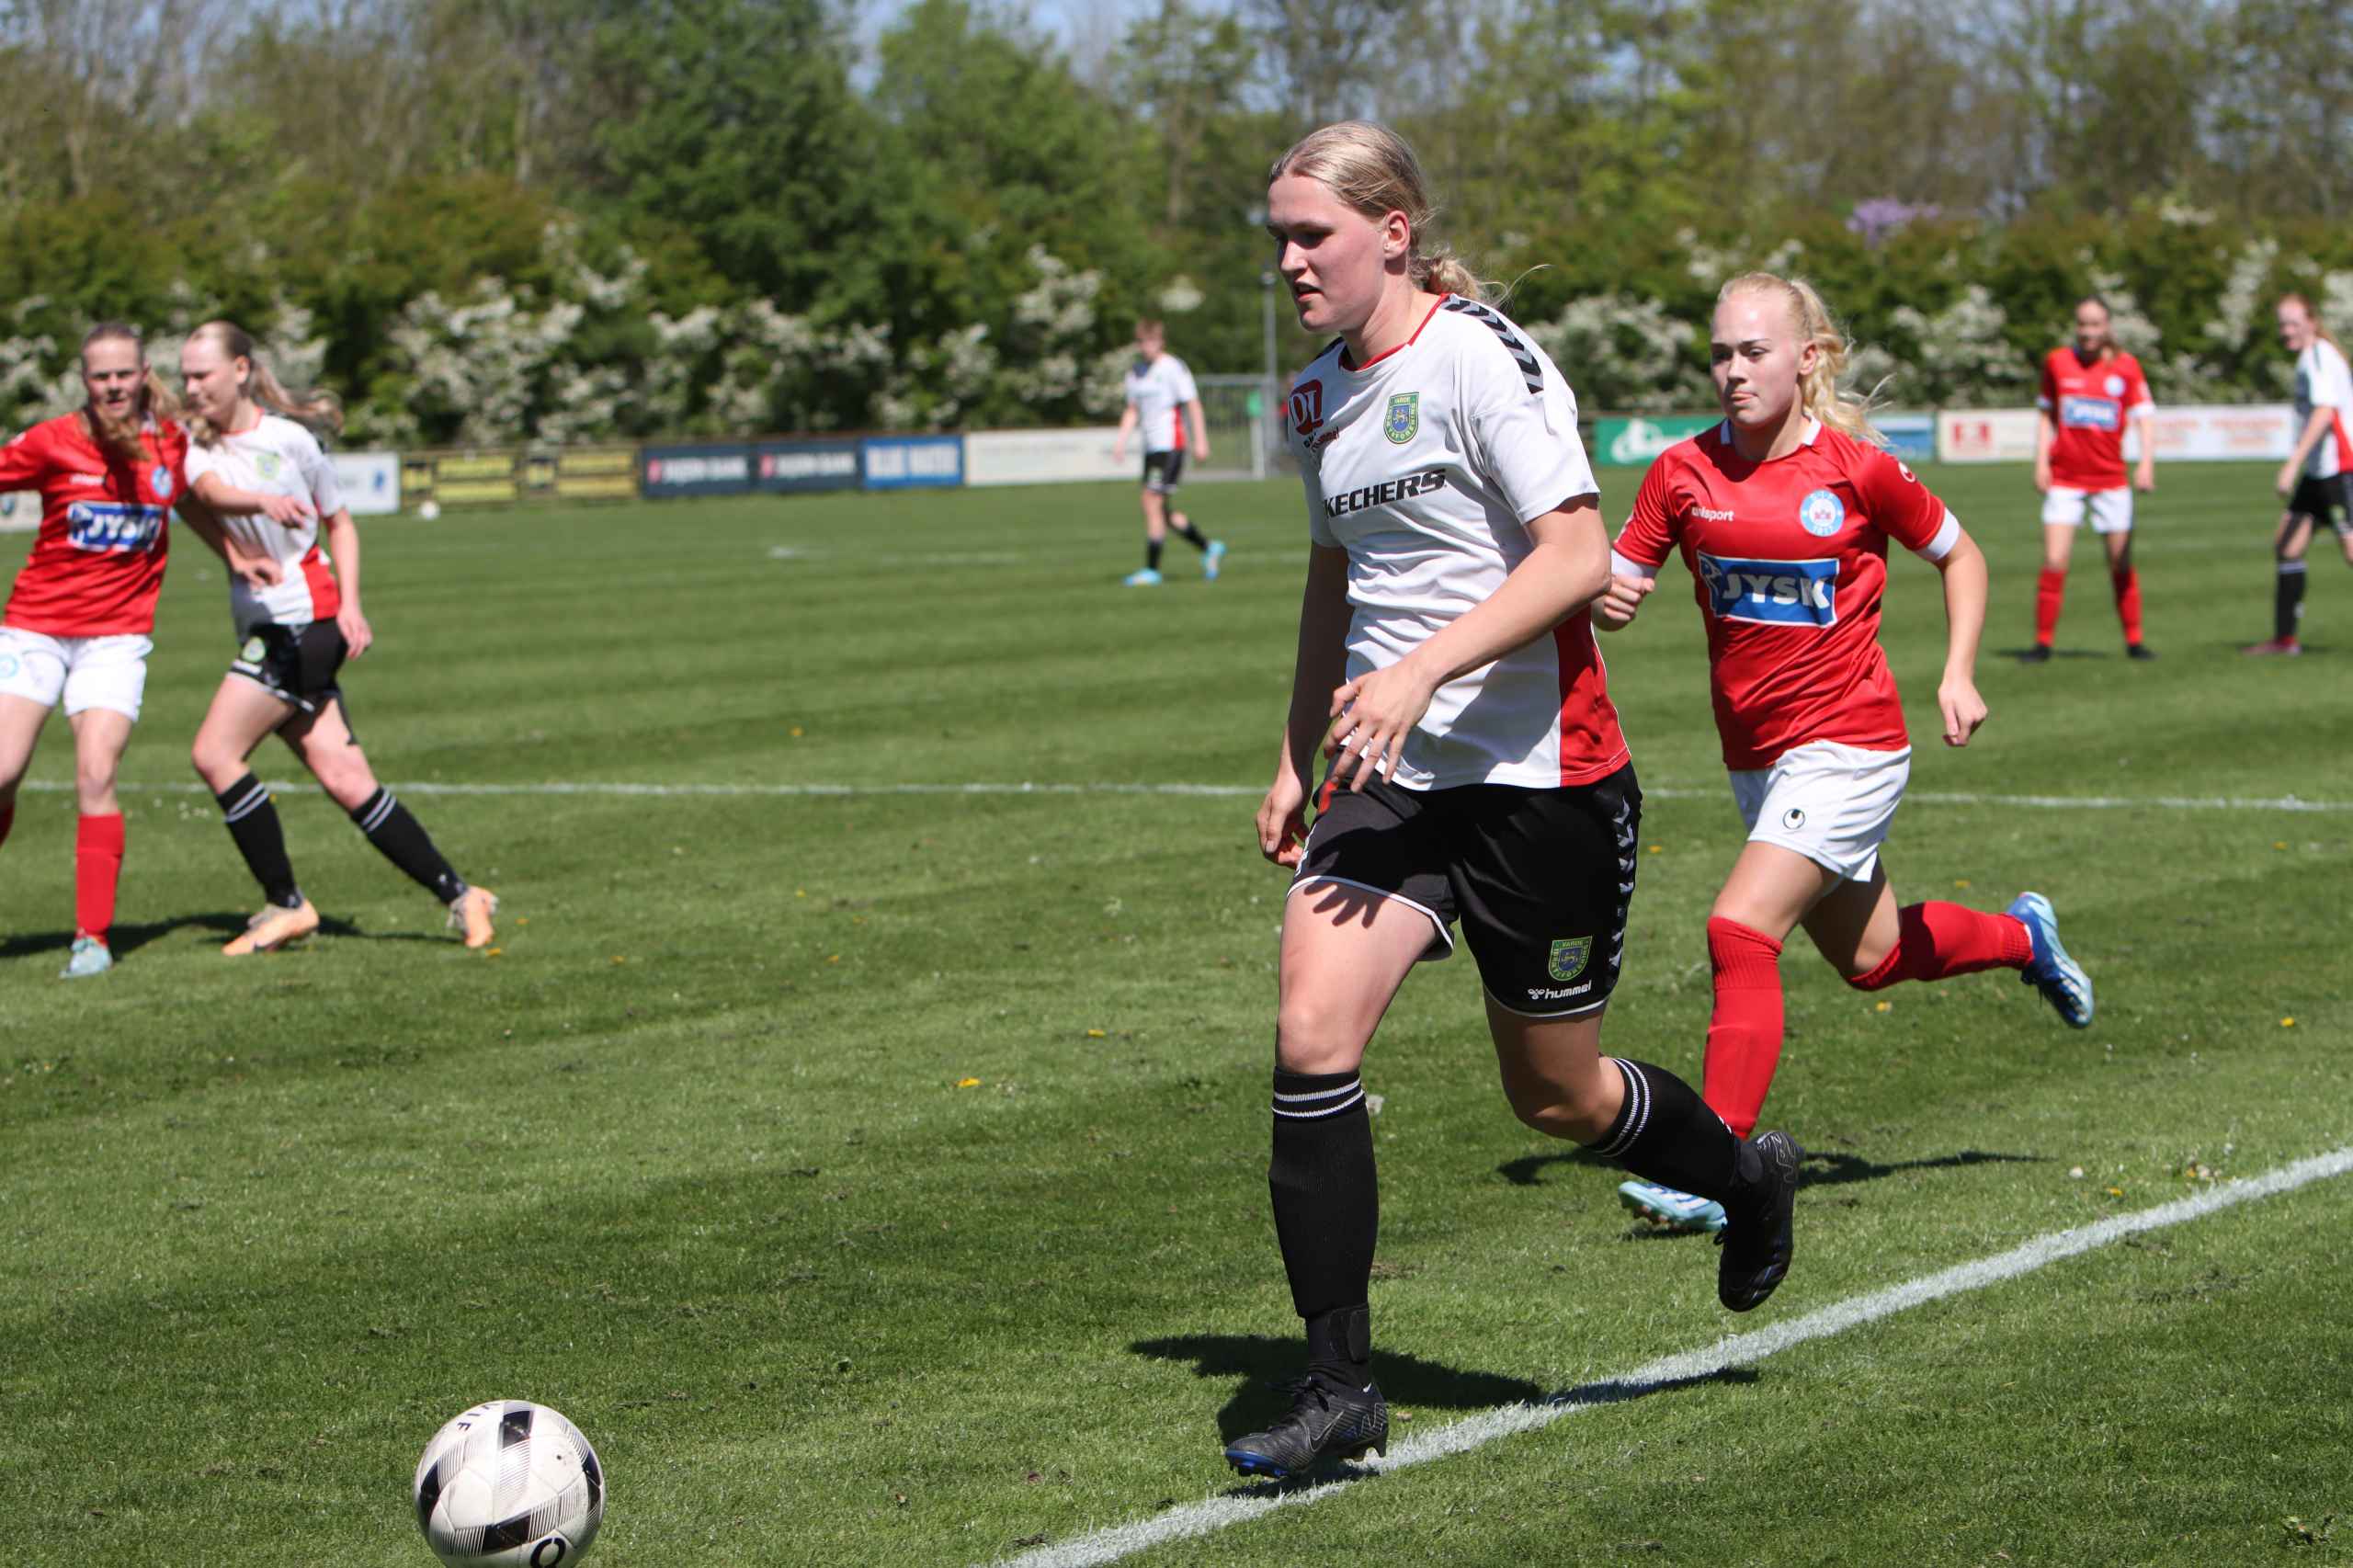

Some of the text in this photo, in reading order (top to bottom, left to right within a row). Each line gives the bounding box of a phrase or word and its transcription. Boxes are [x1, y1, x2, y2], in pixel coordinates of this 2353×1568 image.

[1324, 469, 1447, 518] KECHERS
[1722, 573, 1831, 609] JYSK
[1544, 979, 1592, 1000] hummel
